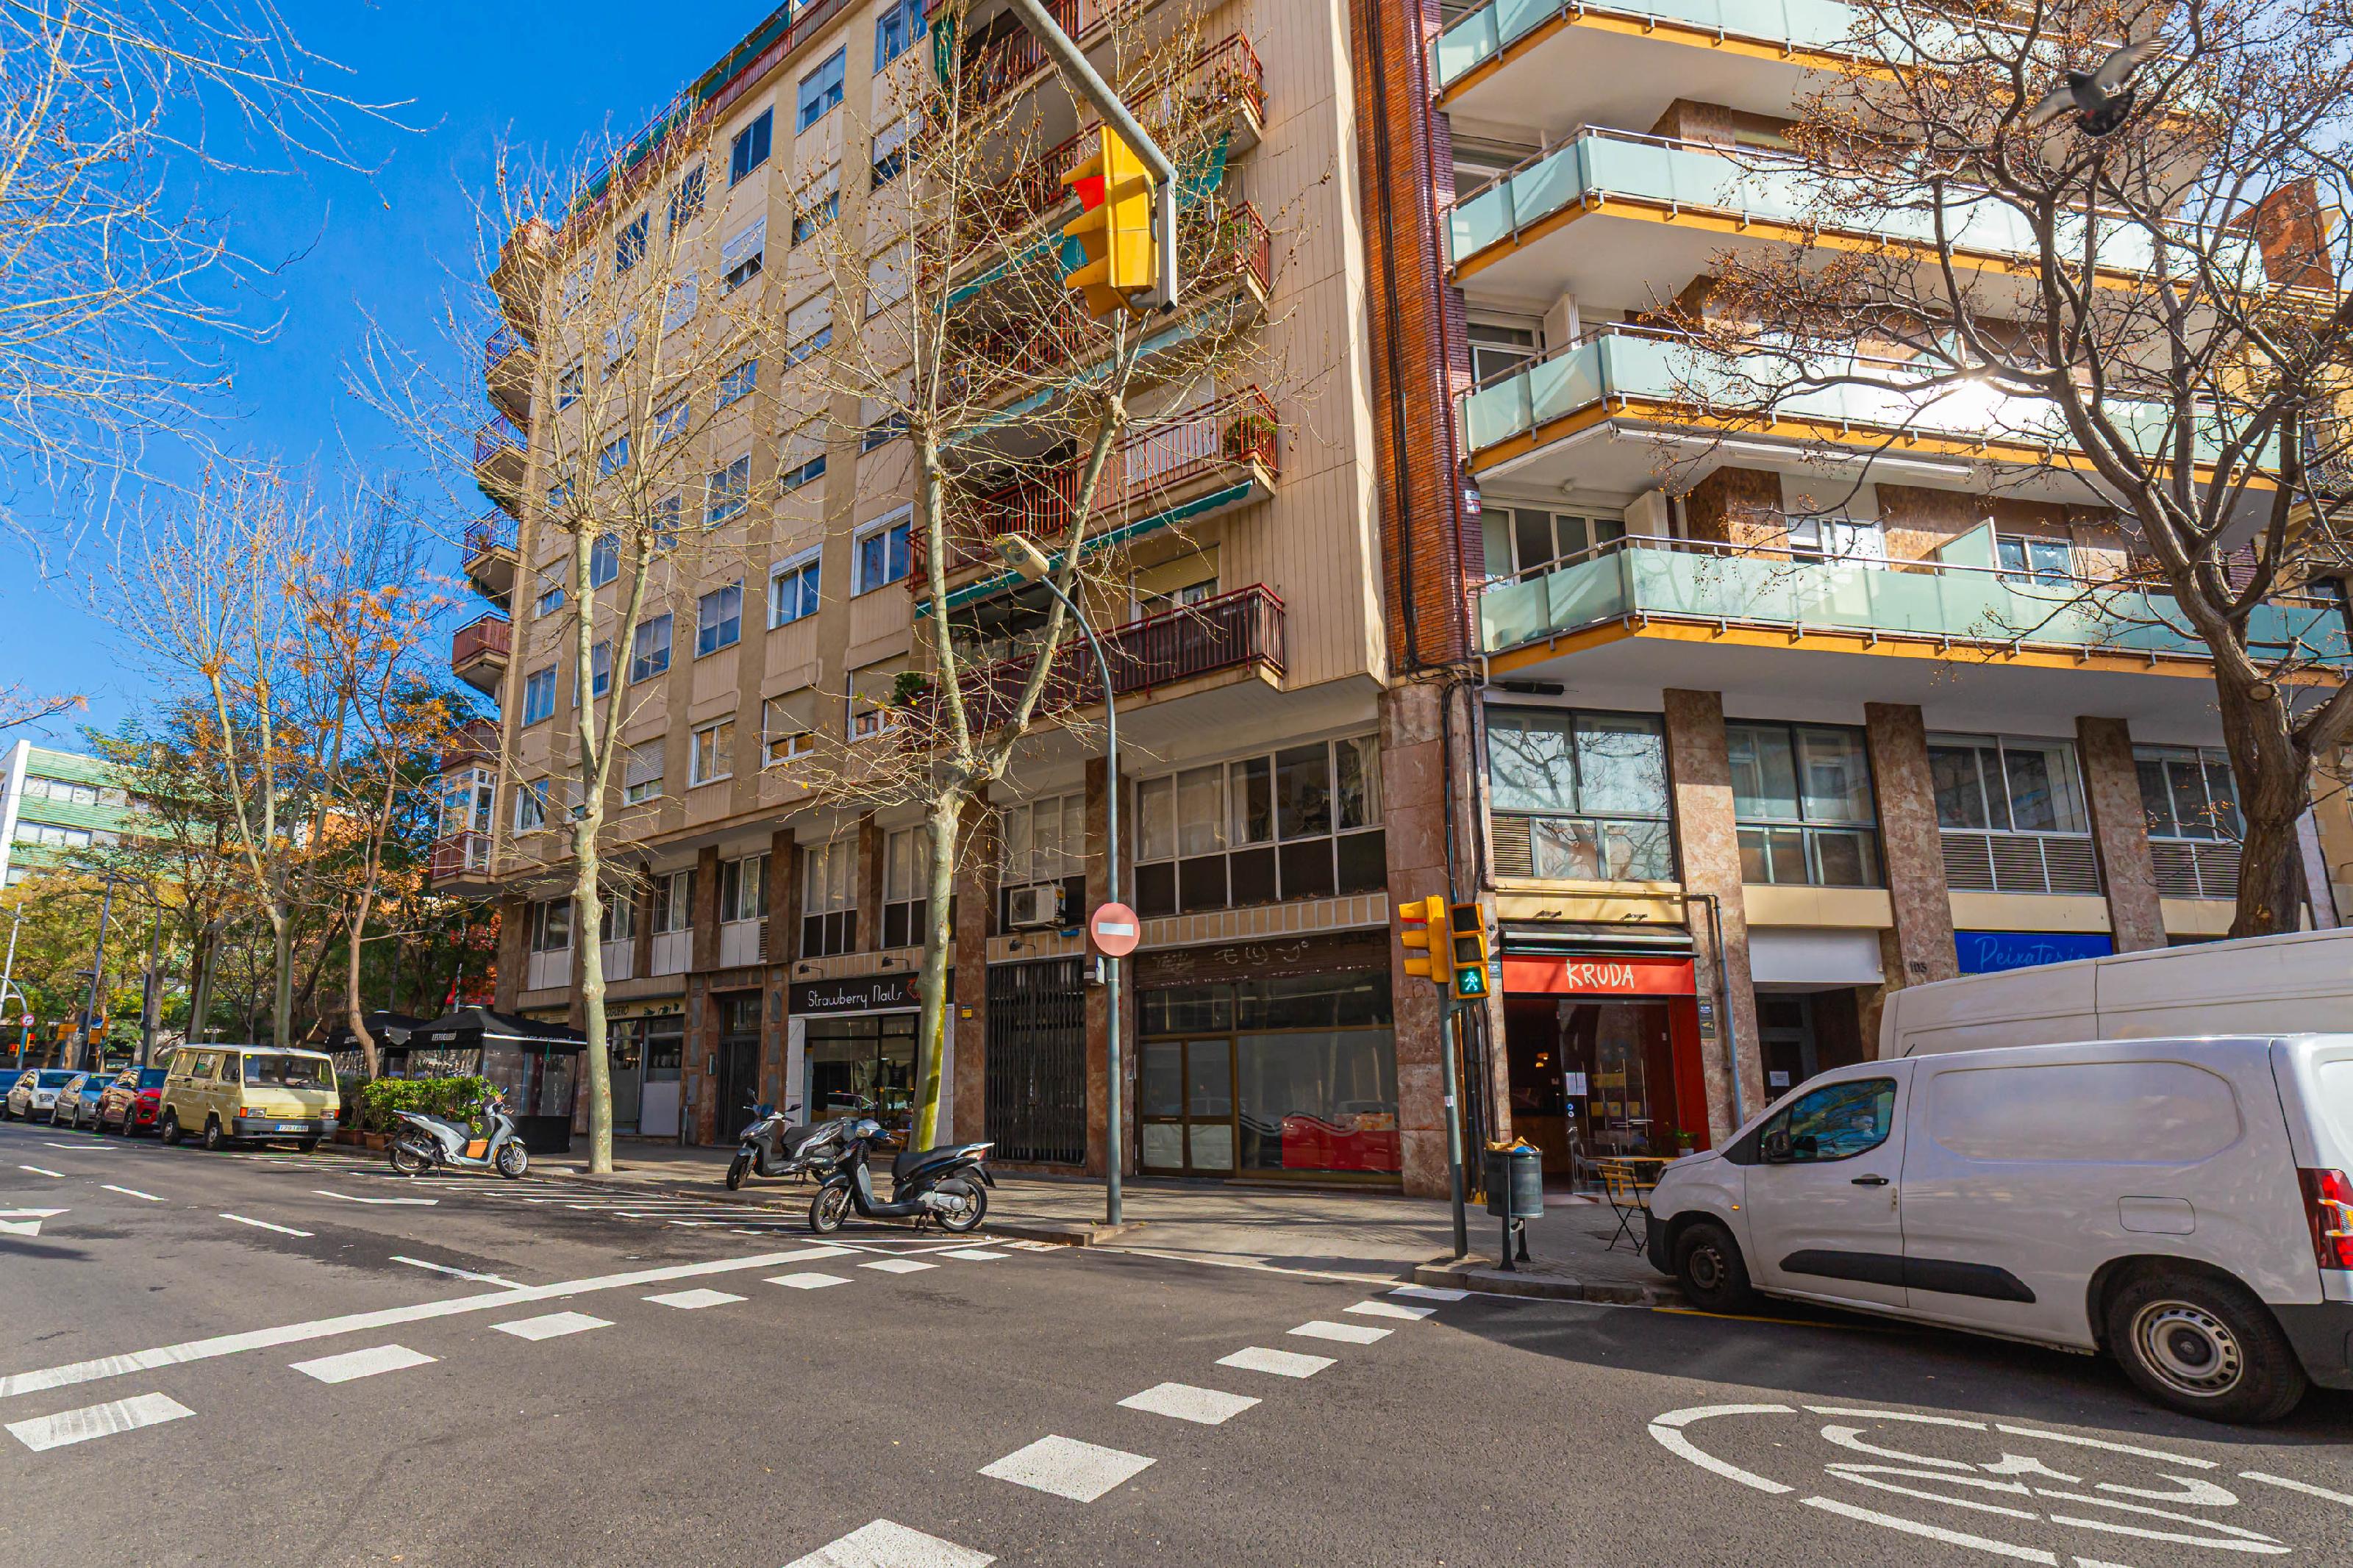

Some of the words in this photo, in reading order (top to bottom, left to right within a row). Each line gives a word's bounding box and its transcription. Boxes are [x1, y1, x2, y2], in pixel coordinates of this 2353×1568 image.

[1565, 959, 1635, 989] KRUDA
[808, 987, 868, 1009] Strawberry
[874, 984, 902, 1002] Nails
